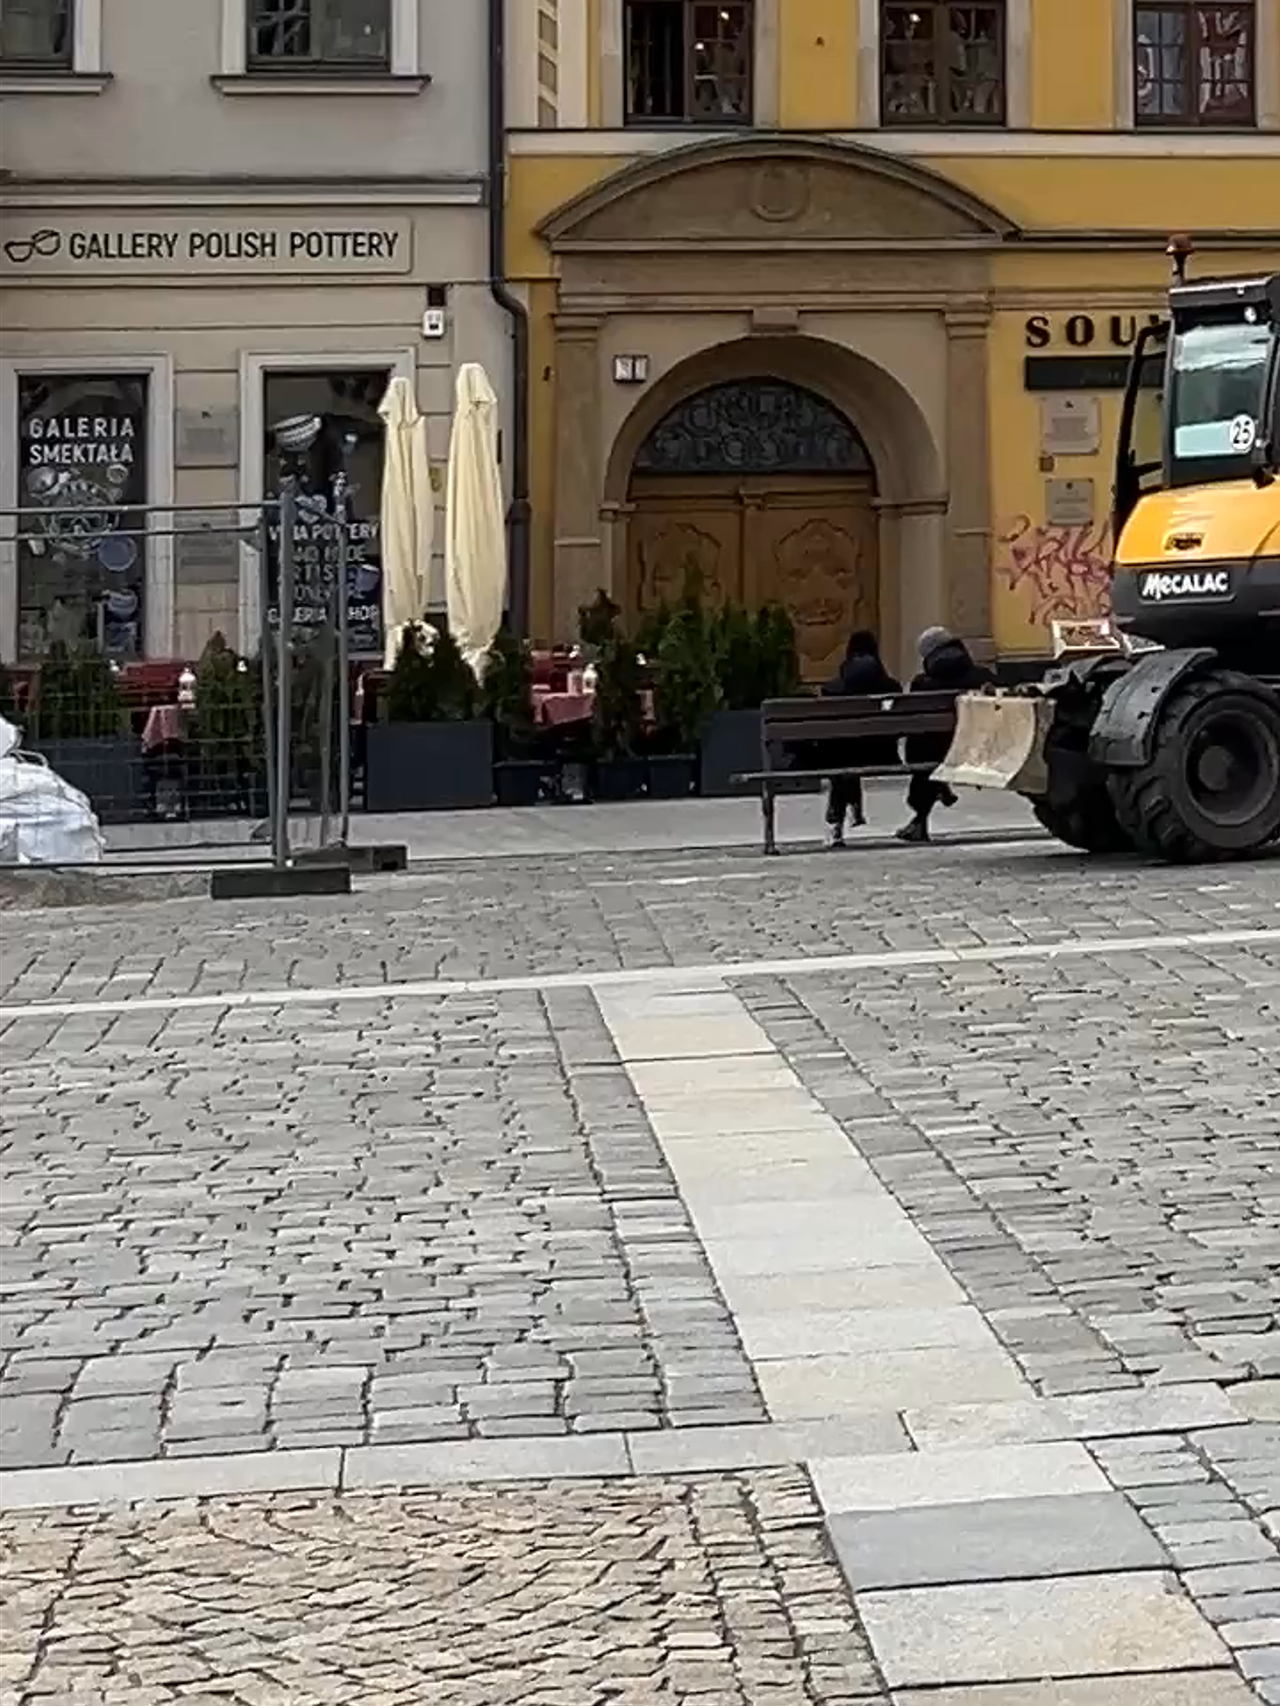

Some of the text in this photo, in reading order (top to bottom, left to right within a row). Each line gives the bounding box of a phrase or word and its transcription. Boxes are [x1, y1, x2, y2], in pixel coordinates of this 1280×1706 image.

[69, 231, 399, 260] GALLERY POLISH POTTERY
[29, 418, 135, 439] GALERIA
[1232, 420, 1251, 445] 25
[29, 442, 134, 465] SMEKTAŁA
